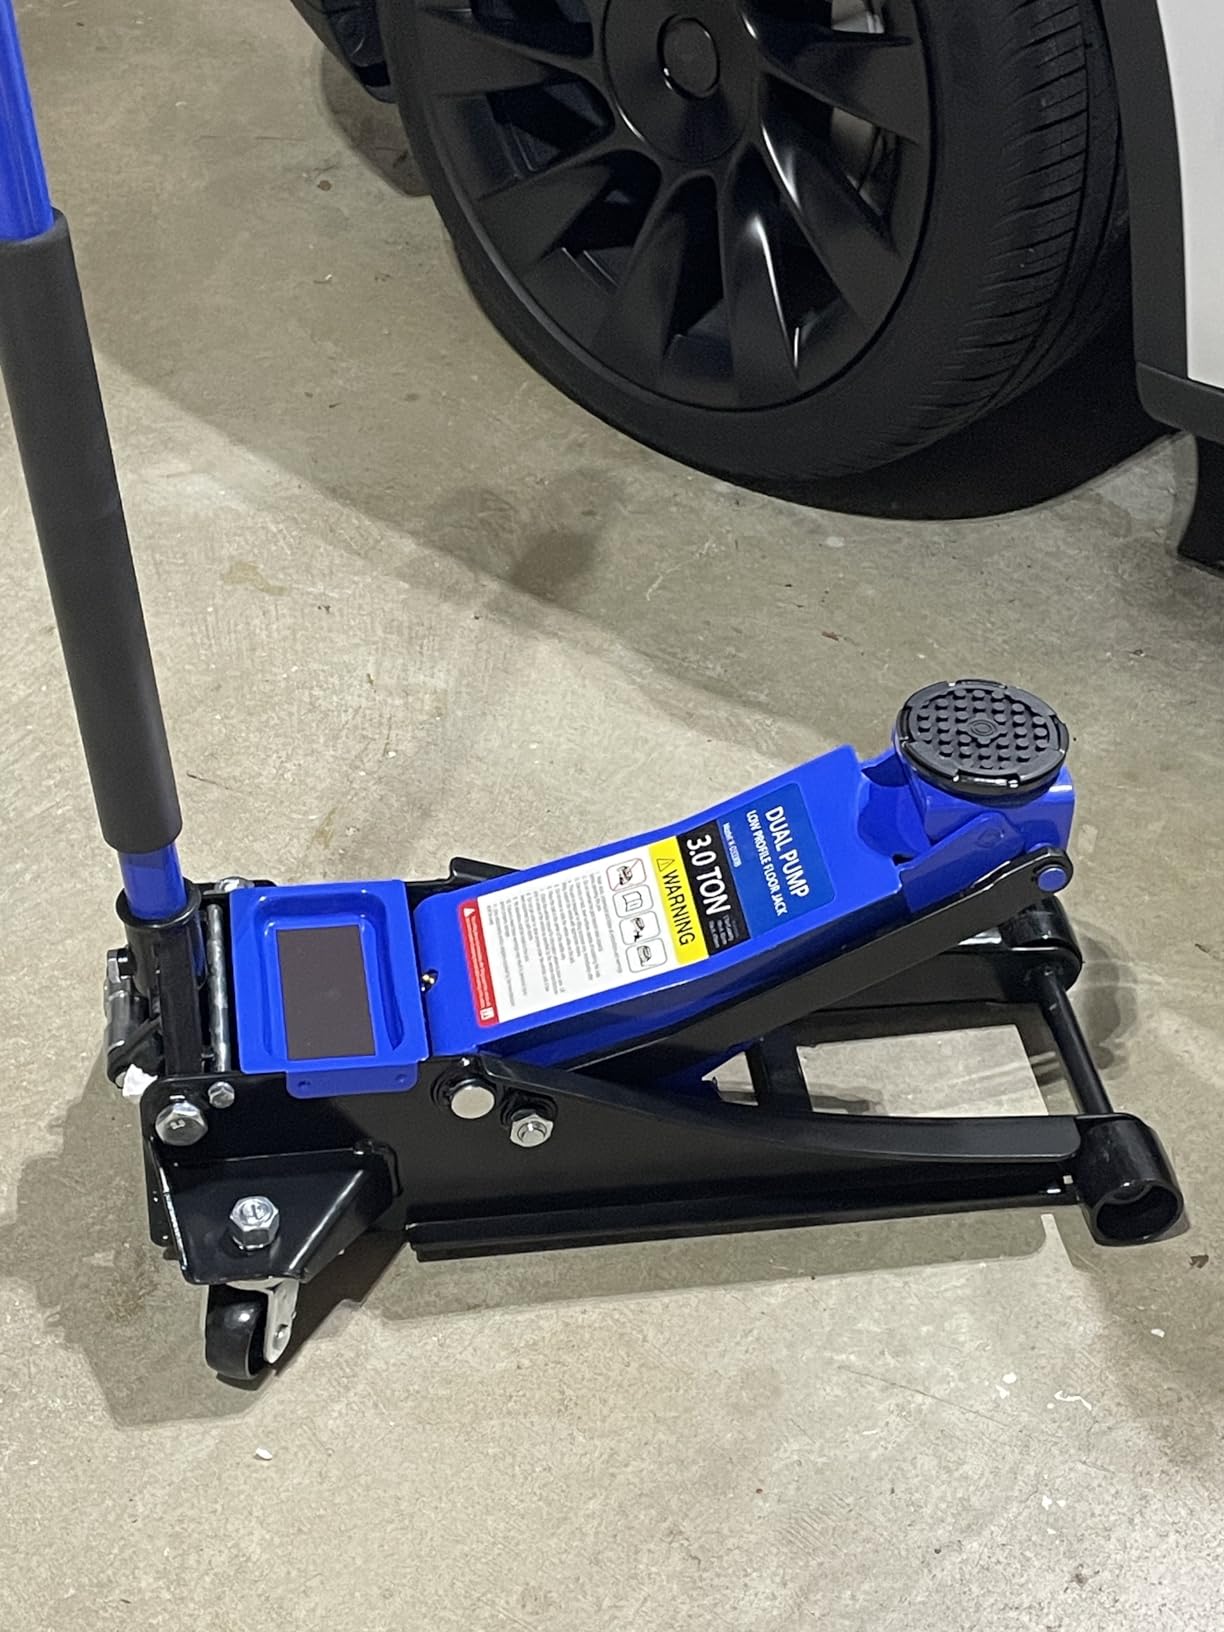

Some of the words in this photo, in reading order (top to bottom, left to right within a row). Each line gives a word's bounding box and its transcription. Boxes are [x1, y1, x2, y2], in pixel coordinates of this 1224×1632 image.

[746, 810, 761, 830] LOW
[687, 834, 715, 865] 3.0
[752, 829, 771, 865] PROFILE
[765, 806, 791, 852] DUAL
[779, 849, 809, 897] PUMP
[696, 866, 731, 915] TON
[763, 864, 780, 894] FLOOR
[662, 869, 695, 946] WARNING
[771, 894, 787, 916] JACK
